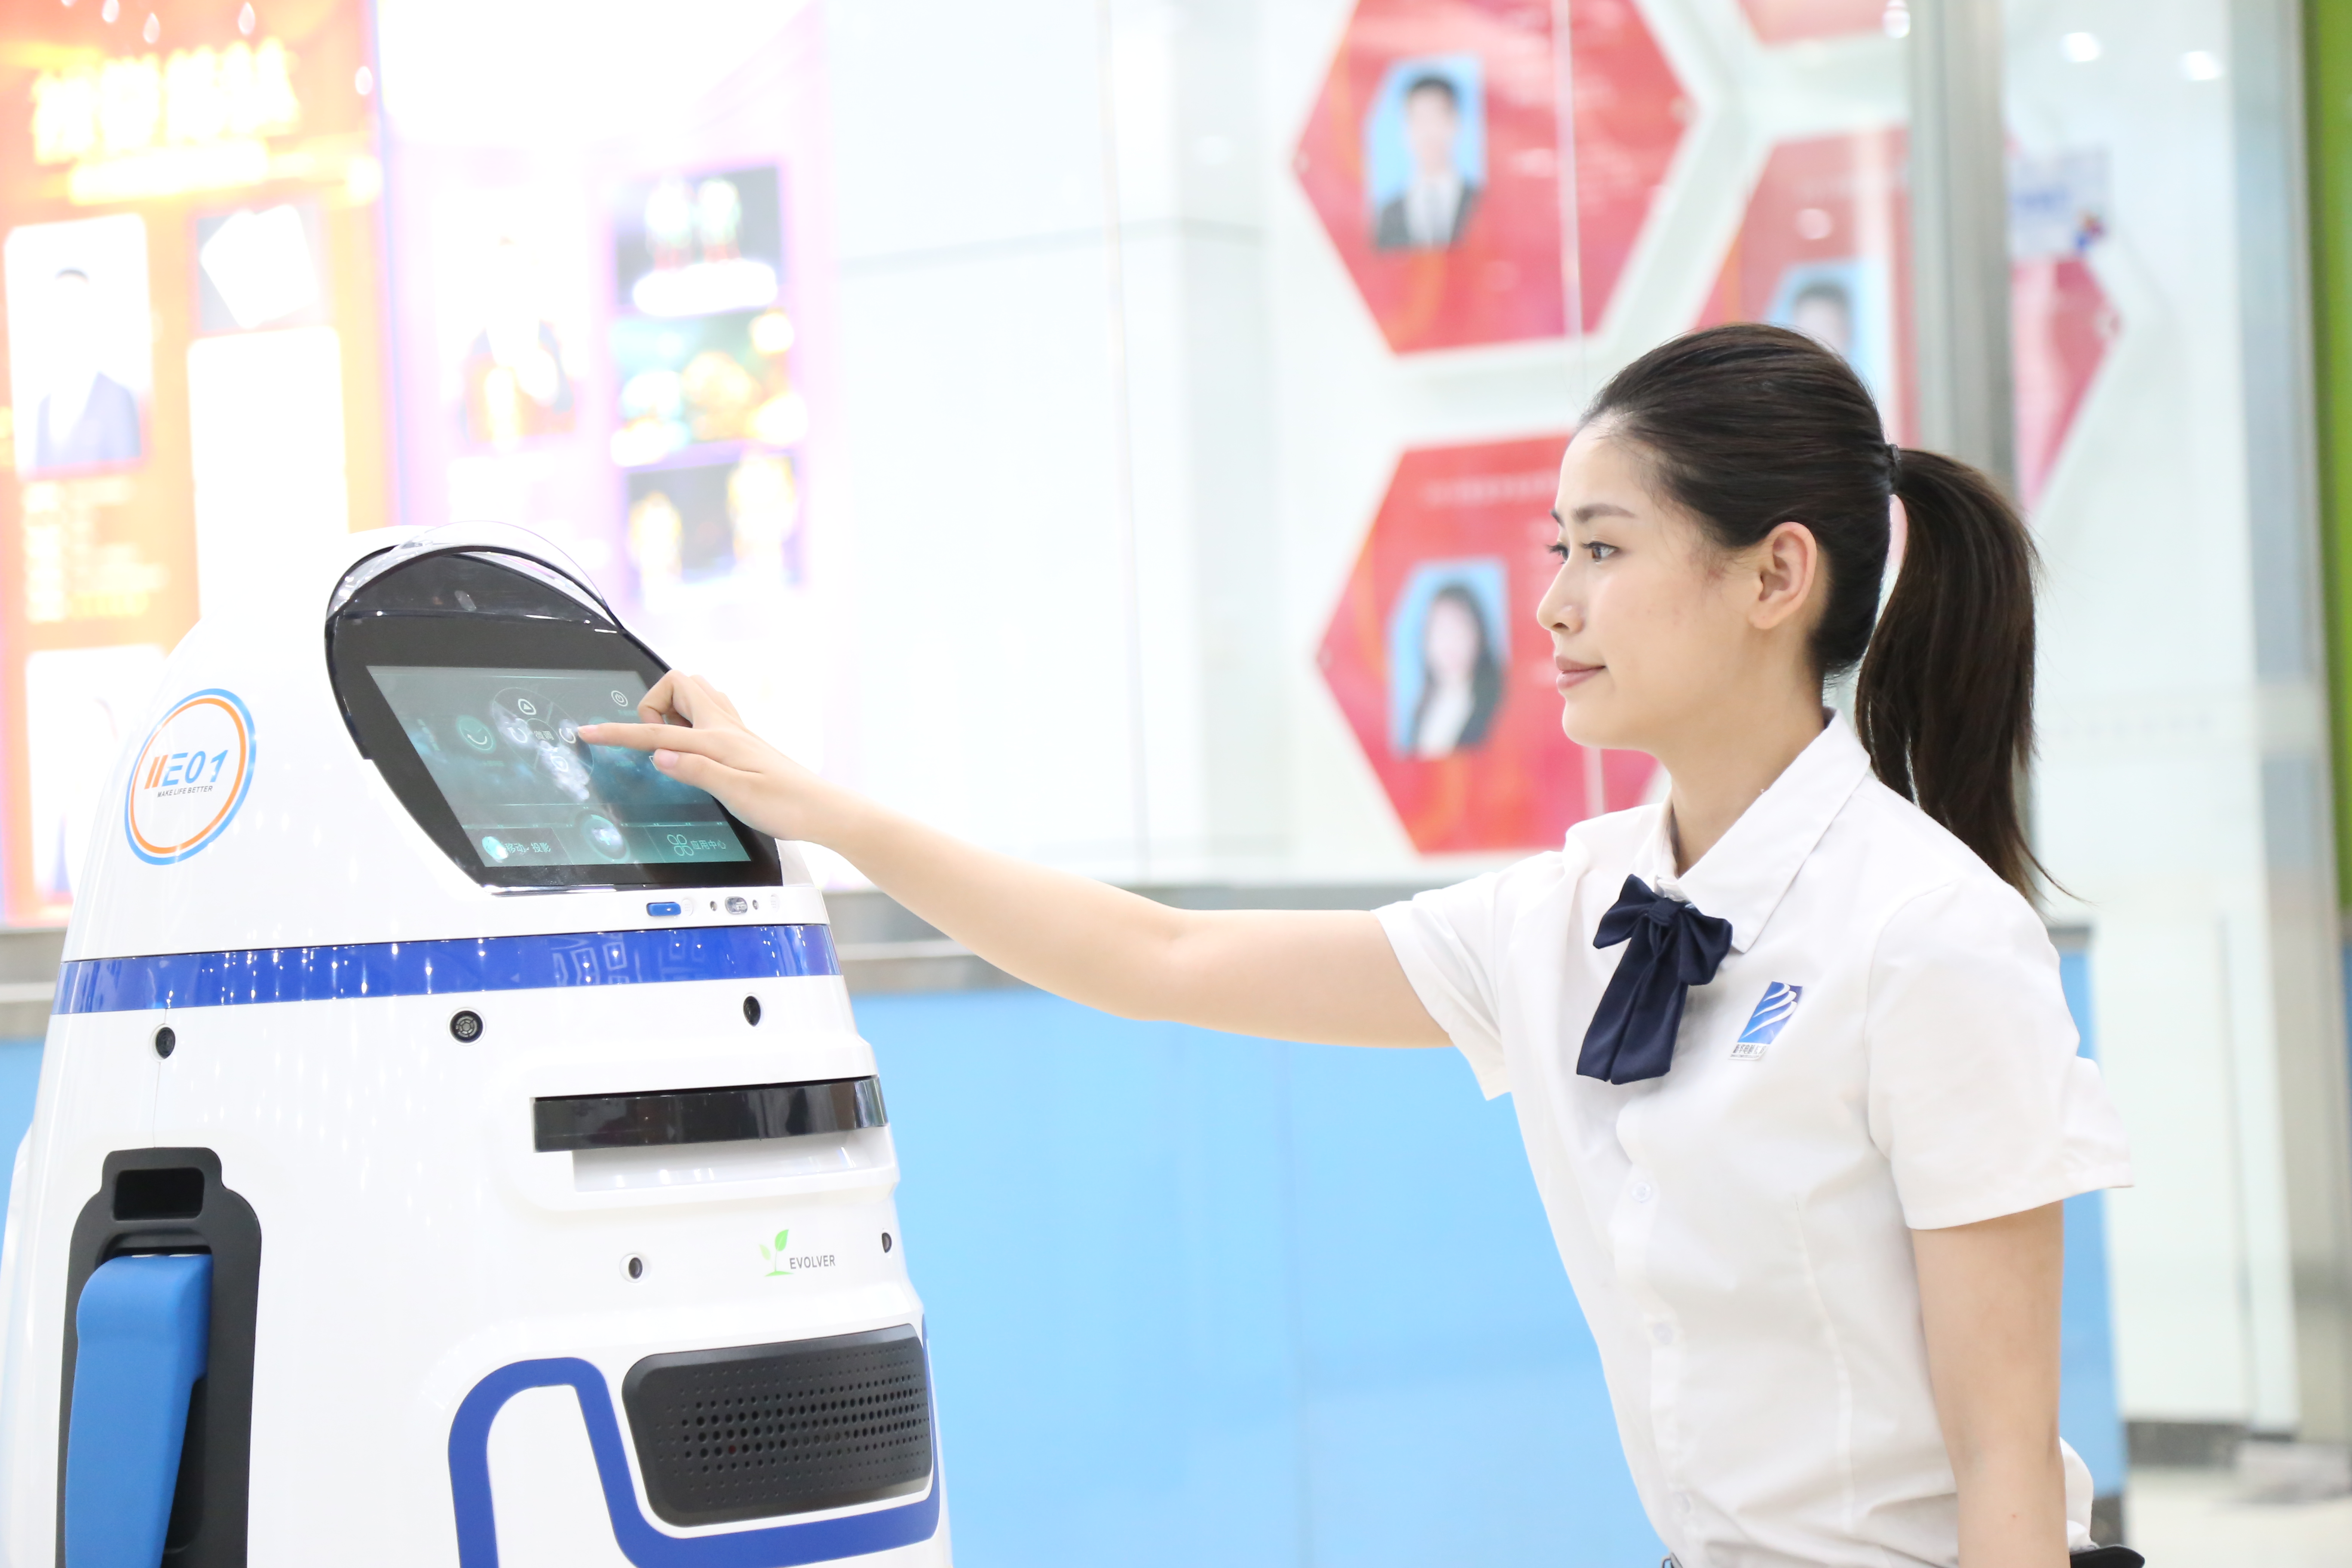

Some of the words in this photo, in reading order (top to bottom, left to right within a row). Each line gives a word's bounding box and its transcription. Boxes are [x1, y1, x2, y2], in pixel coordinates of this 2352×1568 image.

[187, 785, 213, 793] BETTER
[690, 839, 726, 850] 应用中心
[789, 1255, 836, 1269] EVOLVER
